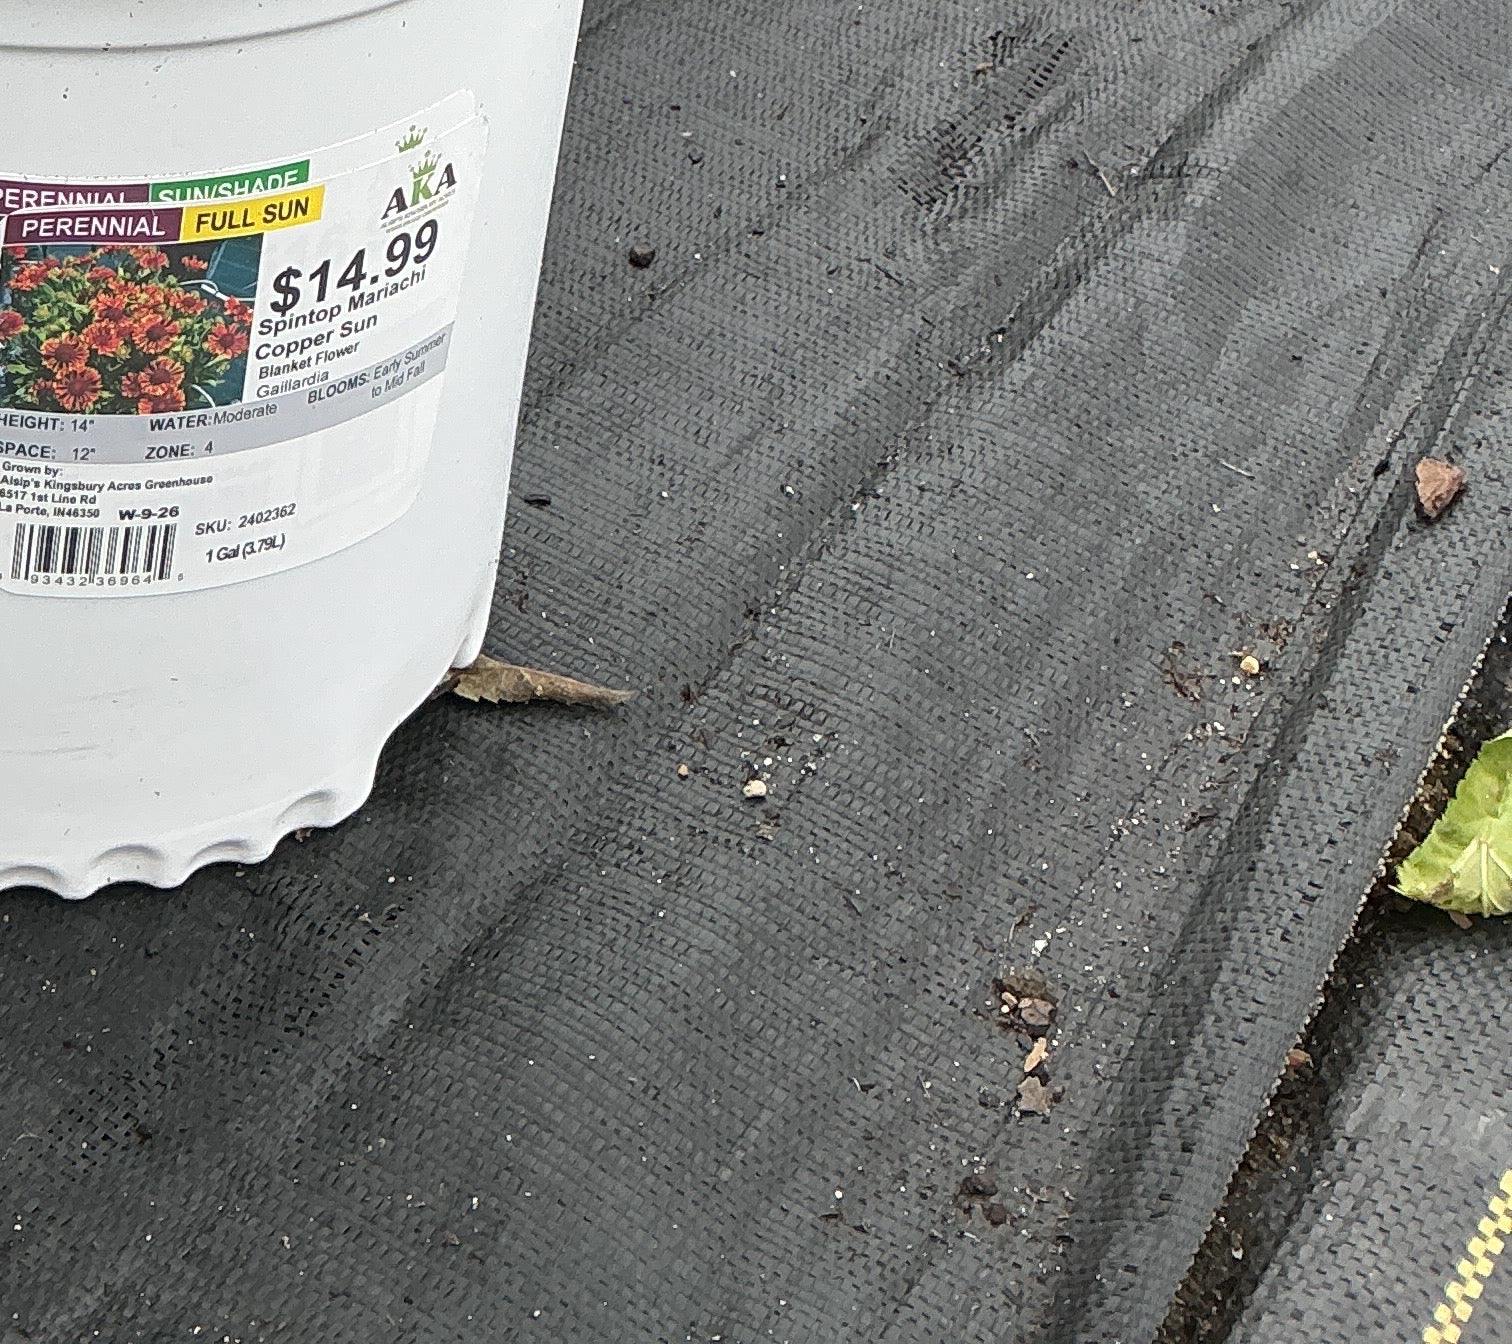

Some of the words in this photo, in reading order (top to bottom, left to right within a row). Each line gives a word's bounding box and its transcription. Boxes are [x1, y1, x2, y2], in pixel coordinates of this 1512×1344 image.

[380, 162, 458, 221] AKA
[22, 216, 166, 238] PERENNIAL
[195, 208, 256, 234] FULL
[263, 195, 310, 224] SUN
[269, 218, 439, 317] $14.99
[257, 303, 342, 337] Spintop
[347, 264, 427, 312] Mariachi
[255, 328, 335, 361] Copper
[339, 313, 378, 338] Sun
[259, 355, 312, 380] Blanket
[315, 340, 361, 365] Flower
[307, 372, 371, 405] BLOOMS:
[373, 360, 402, 380] Early
[404, 332, 447, 366] Summer
[256, 369, 330, 399] Gaillardia
[371, 384, 382, 399] to
[384, 374, 405, 394] Mid
[406, 360, 426, 386] Fall
[144, 444, 195, 461] ZONE:
[203, 440, 214, 455] 4
[0, 475, 41, 490] Alsip's
[44, 479, 105, 493] Kingsbury
[107, 480, 142, 492] Acres
[144, 475, 214, 490] Greenhouse
[2, 461, 42, 475] Grown
[44, 463, 64, 478] by:
[0, 488, 28, 501] 6517
[51, 492, 77, 505] Line
[79, 494, 97, 505] Rd
[15, 503, 51, 518] Porte,
[118, 506, 181, 521] W-9-26
[194, 518, 232, 536] SKU:
[205, 548, 214, 563] 1
[216, 544, 241, 562] Gal
